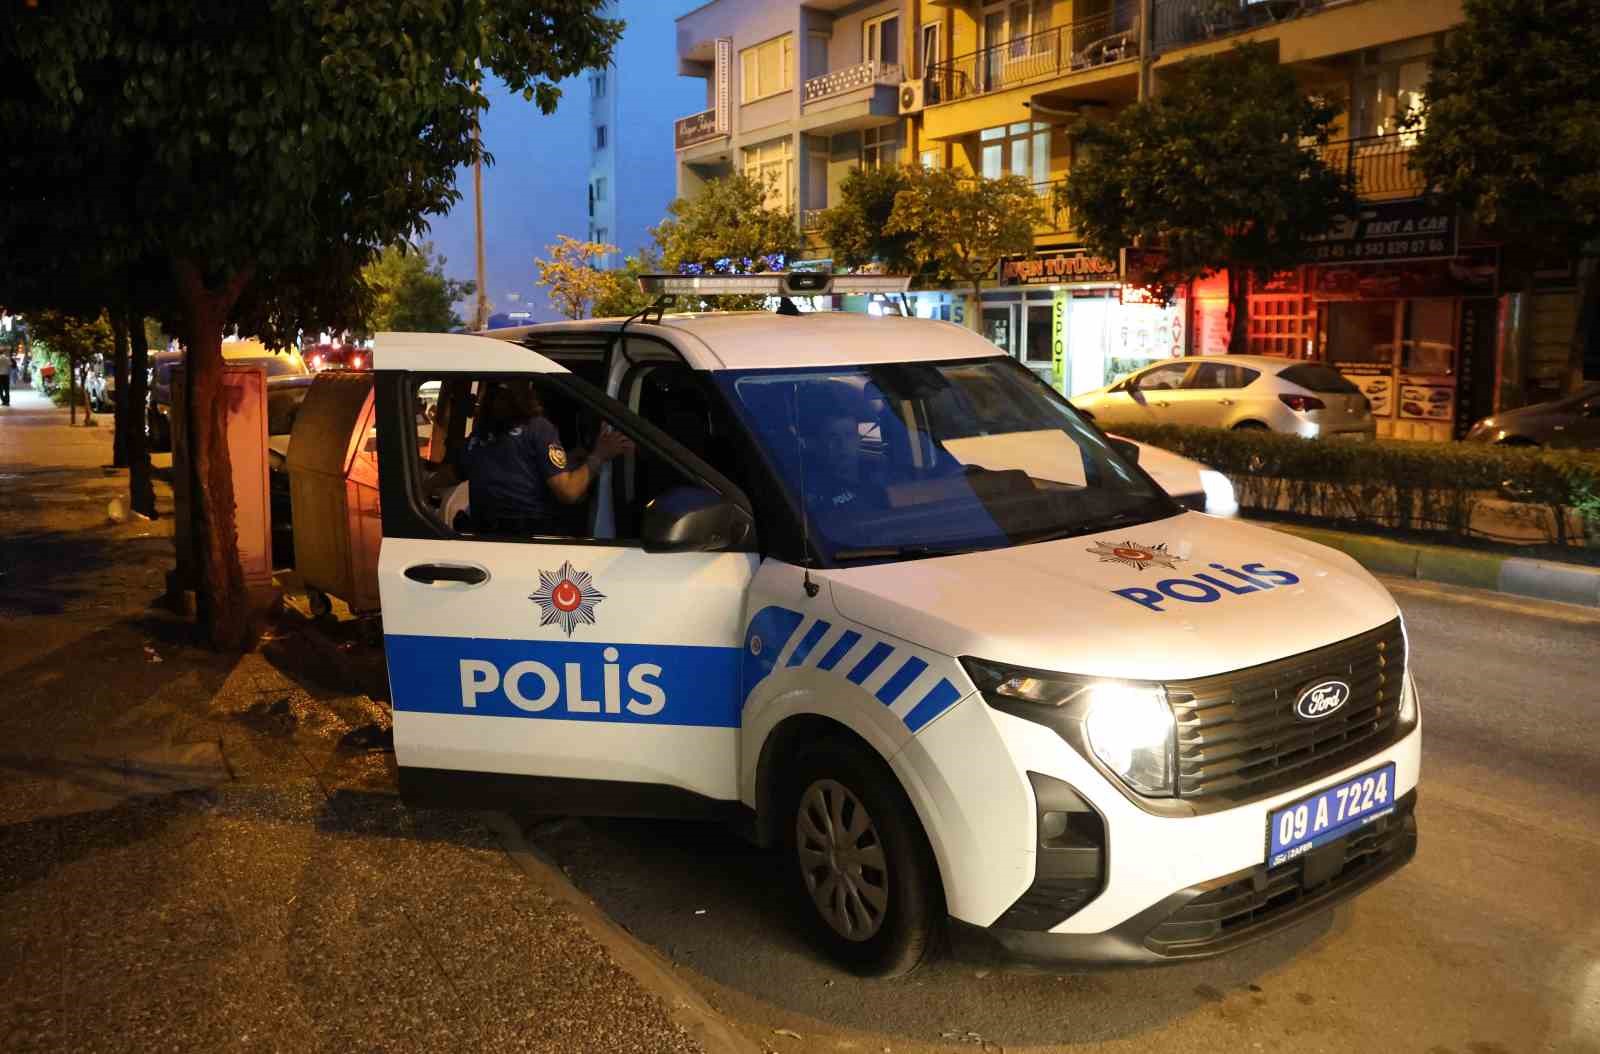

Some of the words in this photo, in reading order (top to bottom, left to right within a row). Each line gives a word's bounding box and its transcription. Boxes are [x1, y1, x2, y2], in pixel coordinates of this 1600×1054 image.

[1366, 220, 1401, 234] RENT
[1403, 219, 1415, 232] A
[1417, 216, 1450, 230] CAR
[1110, 562, 1299, 612] POLİS
[459, 646, 667, 717] POLİS
[1308, 686, 1340, 714] Ford
[1279, 805, 1309, 846] 09
[1313, 796, 1329, 832] A
[1336, 772, 1388, 822] 7224
